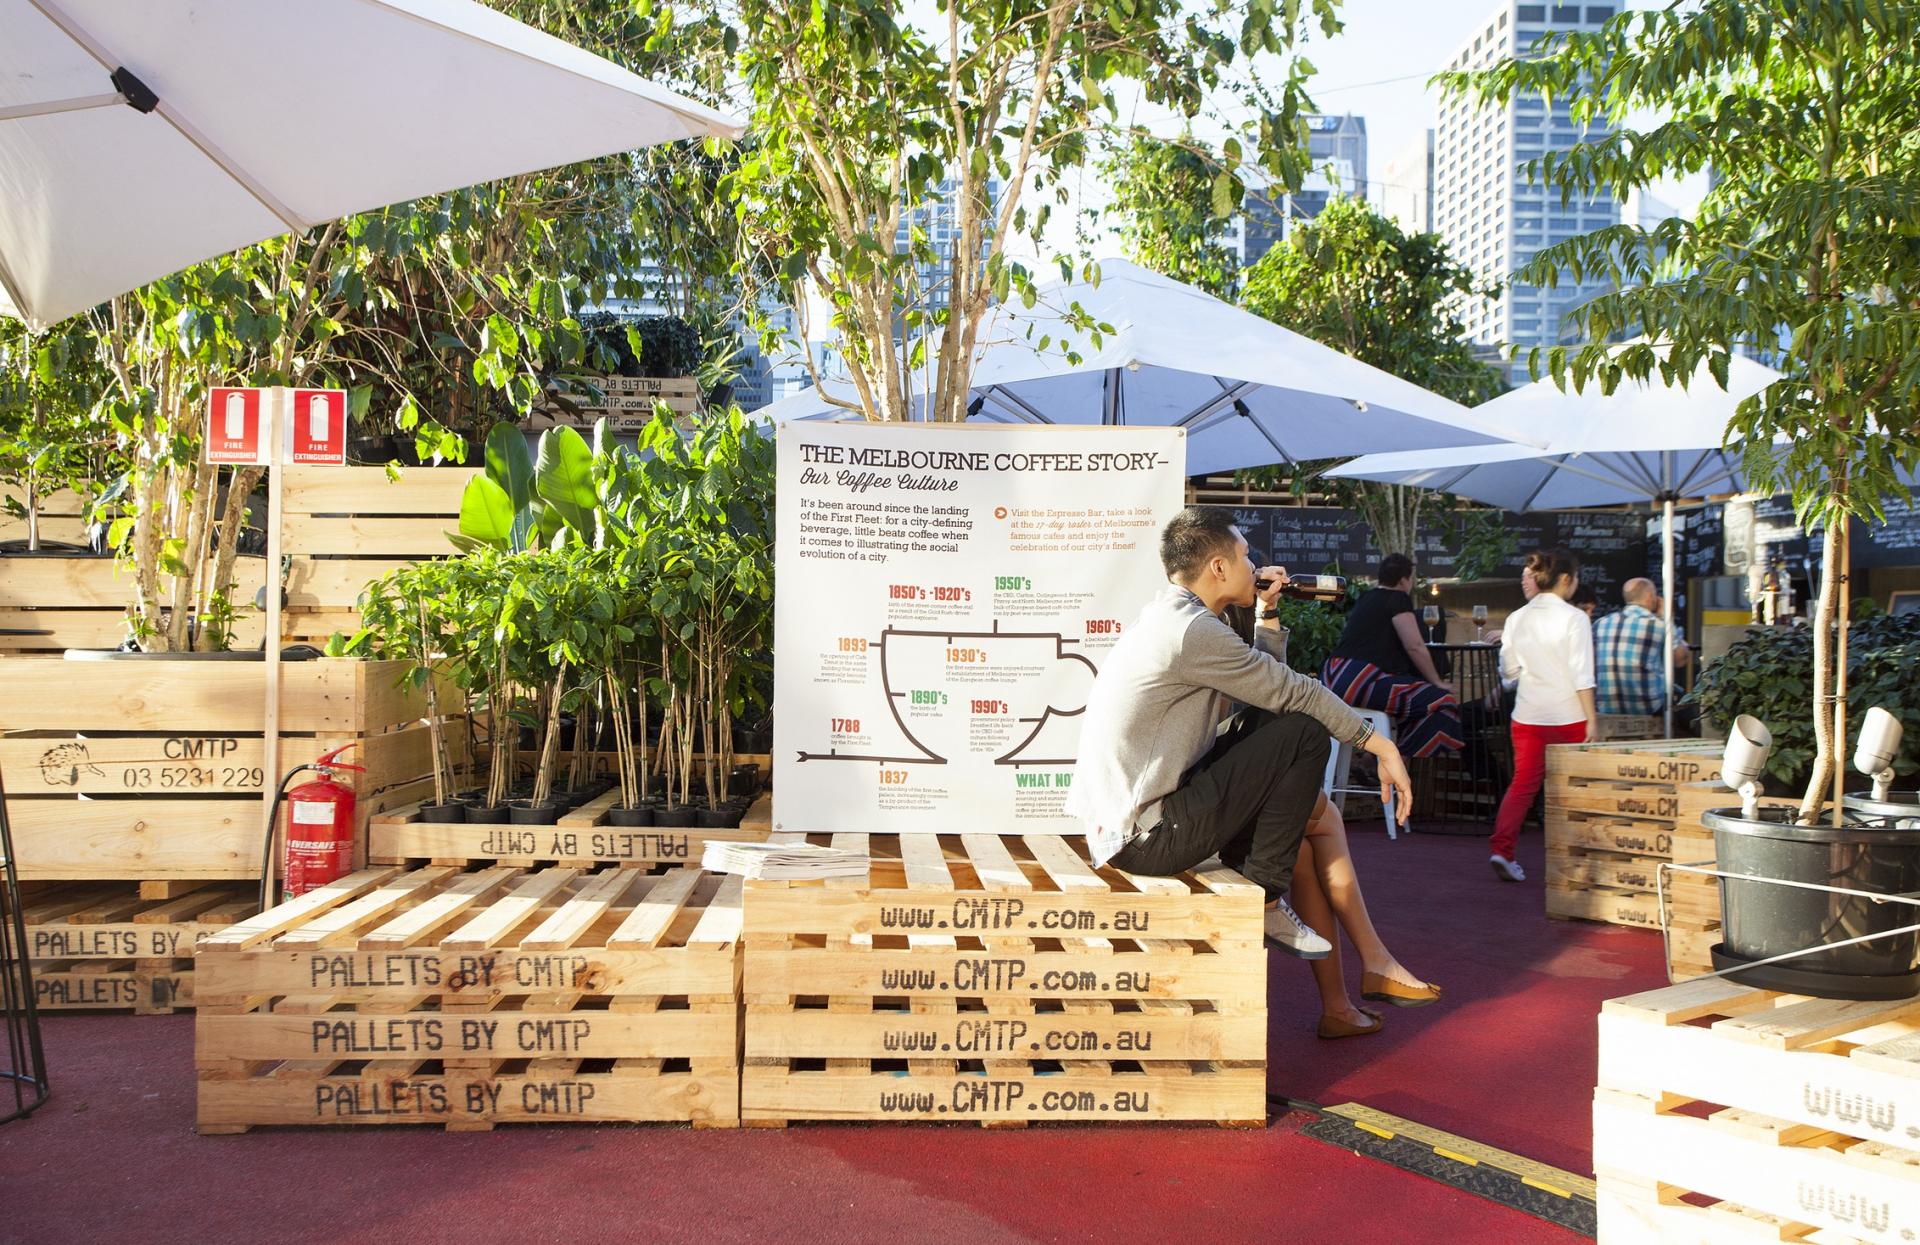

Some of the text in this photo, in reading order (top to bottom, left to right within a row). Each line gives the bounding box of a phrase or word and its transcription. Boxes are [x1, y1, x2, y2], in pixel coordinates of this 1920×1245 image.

[621, 380, 662, 390] PALLETS
[224, 441, 244, 449] FIRE
[308, 443, 329, 451] FIRE
[800, 444, 844, 464] THE
[849, 447, 989, 471] MELBOURNE
[994, 453, 1082, 471] COFFEE
[800, 467, 959, 493] Our Coffee Culture
[800, 498, 969, 517] It's been around since the landing
[1010, 508, 1030, 517] Visit
[1031, 508, 1045, 518] the
[1047, 508, 1086, 520] Espresso
[1107, 508, 1125, 517] take
[1135, 507, 1153, 517] look
[800, 511, 810, 521] of
[812, 511, 828, 522] the
[830, 512, 853, 523] First
[885, 515, 898, 525] for
[901, 518, 908, 526] a
[910, 516, 973, 530] city-defining
[1010, 520, 1020, 529] at
[1022, 520, 1034, 529] the
[1093, 520, 1103, 529] of
[1104, 518, 1156, 529] Melbourne's
[800, 523, 969, 541] beverage, little beats coffee when
[1010, 531, 1040, 541] famous
[1067, 532, 1084, 541] and
[1085, 532, 1109, 544] enjoy
[1111, 530, 1125, 540] the
[800, 536, 959, 552] it comes to illustrating the social
[1010, 542, 1059, 552] celebration
[1061, 543, 1070, 552] of
[1071, 544, 1085, 552] our
[1087, 542, 1110, 554] city's
[800, 549, 889, 564] evolution of a city.
[995, 575, 1031, 591] 1950's
[889, 584, 926, 600] 1850's
[1086, 619, 1121, 634] 1960's
[838, 637, 867, 652] 1893
[946, 648, 987, 663] 1930's
[911, 689, 948, 705] 1890's
[971, 699, 1008, 714] 1990's
[831, 718, 860, 733] 1788
[163, 738, 238, 759] CMTP
[123, 766, 264, 788] 03 5231 229
[879, 770, 909, 785] 1837
[1016, 773, 1074, 788] WHAT NO
[290, 840, 336, 850] EVERSAFE
[480, 831, 689, 858] PALLETS BY CMTP
[880, 898, 1149, 931] www.CMTP.com.au
[35, 931, 137, 957] PALLETS
[152, 931, 181, 956] BY
[311, 955, 589, 988] PALLETS BY CMTP
[881, 959, 1150, 992] www.CMTP.com.au
[34, 978, 137, 1005] PALLETS
[312, 1019, 590, 1053] PALLETS BY CMTP
[883, 1020, 1152, 1052] www.CMTP.com.au
[316, 1081, 596, 1117] PALLETS BY CMTP
[879, 1081, 1149, 1113] www.CMTP.com.au
